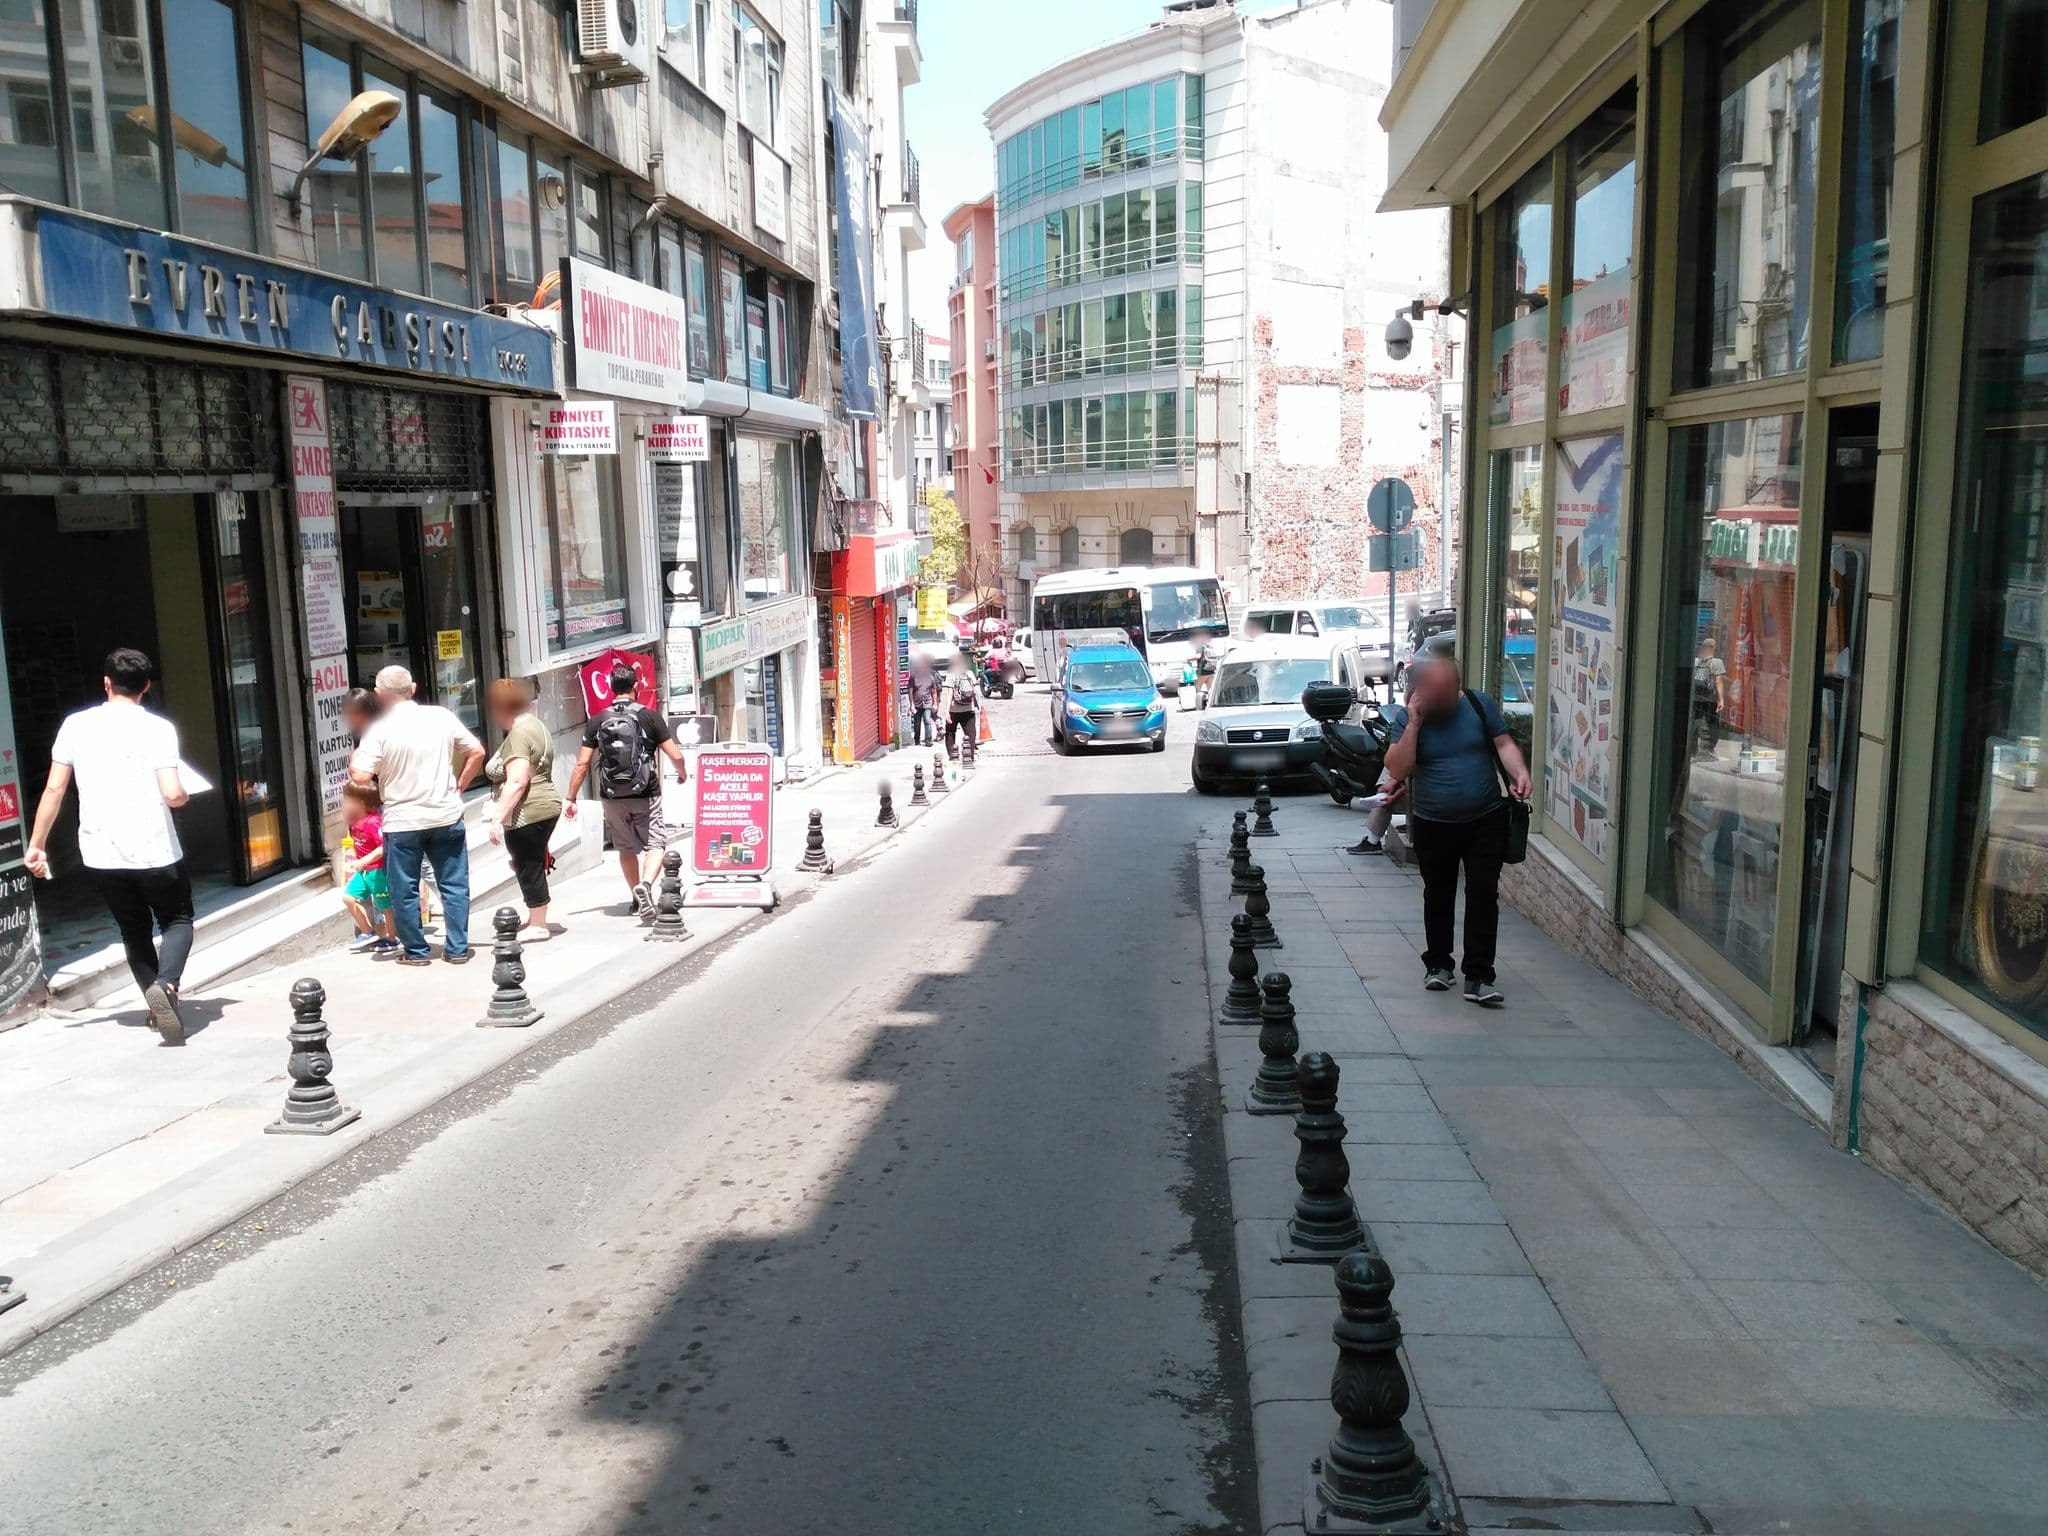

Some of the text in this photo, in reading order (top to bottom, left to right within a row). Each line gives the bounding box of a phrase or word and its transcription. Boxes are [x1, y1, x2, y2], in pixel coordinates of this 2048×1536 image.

[124, 248, 288, 328] EVREN
[331, 295, 470, 364] ÇARŞISI
[581, 285, 681, 370] EMNİYET KIRTASİYE
[550, 409, 603, 423] EMNİYET
[544, 424, 610, 439] KIRTASİYE
[652, 423, 698, 434] EMNİYET
[648, 437, 704, 448] KIRTASİYE
[293, 446, 332, 476] EMRE
[705, 624, 745, 652] MOPAK
[314, 659, 347, 693] ACİL
[331, 720, 338, 732] VE
[701, 757, 768, 767] KAŞE MERKEZİ
[704, 769, 763, 782] 5 DAKİDA DA
[719, 783, 748, 791] ACELE
[703, 793, 763, 803] KAŞE YAPILIR
